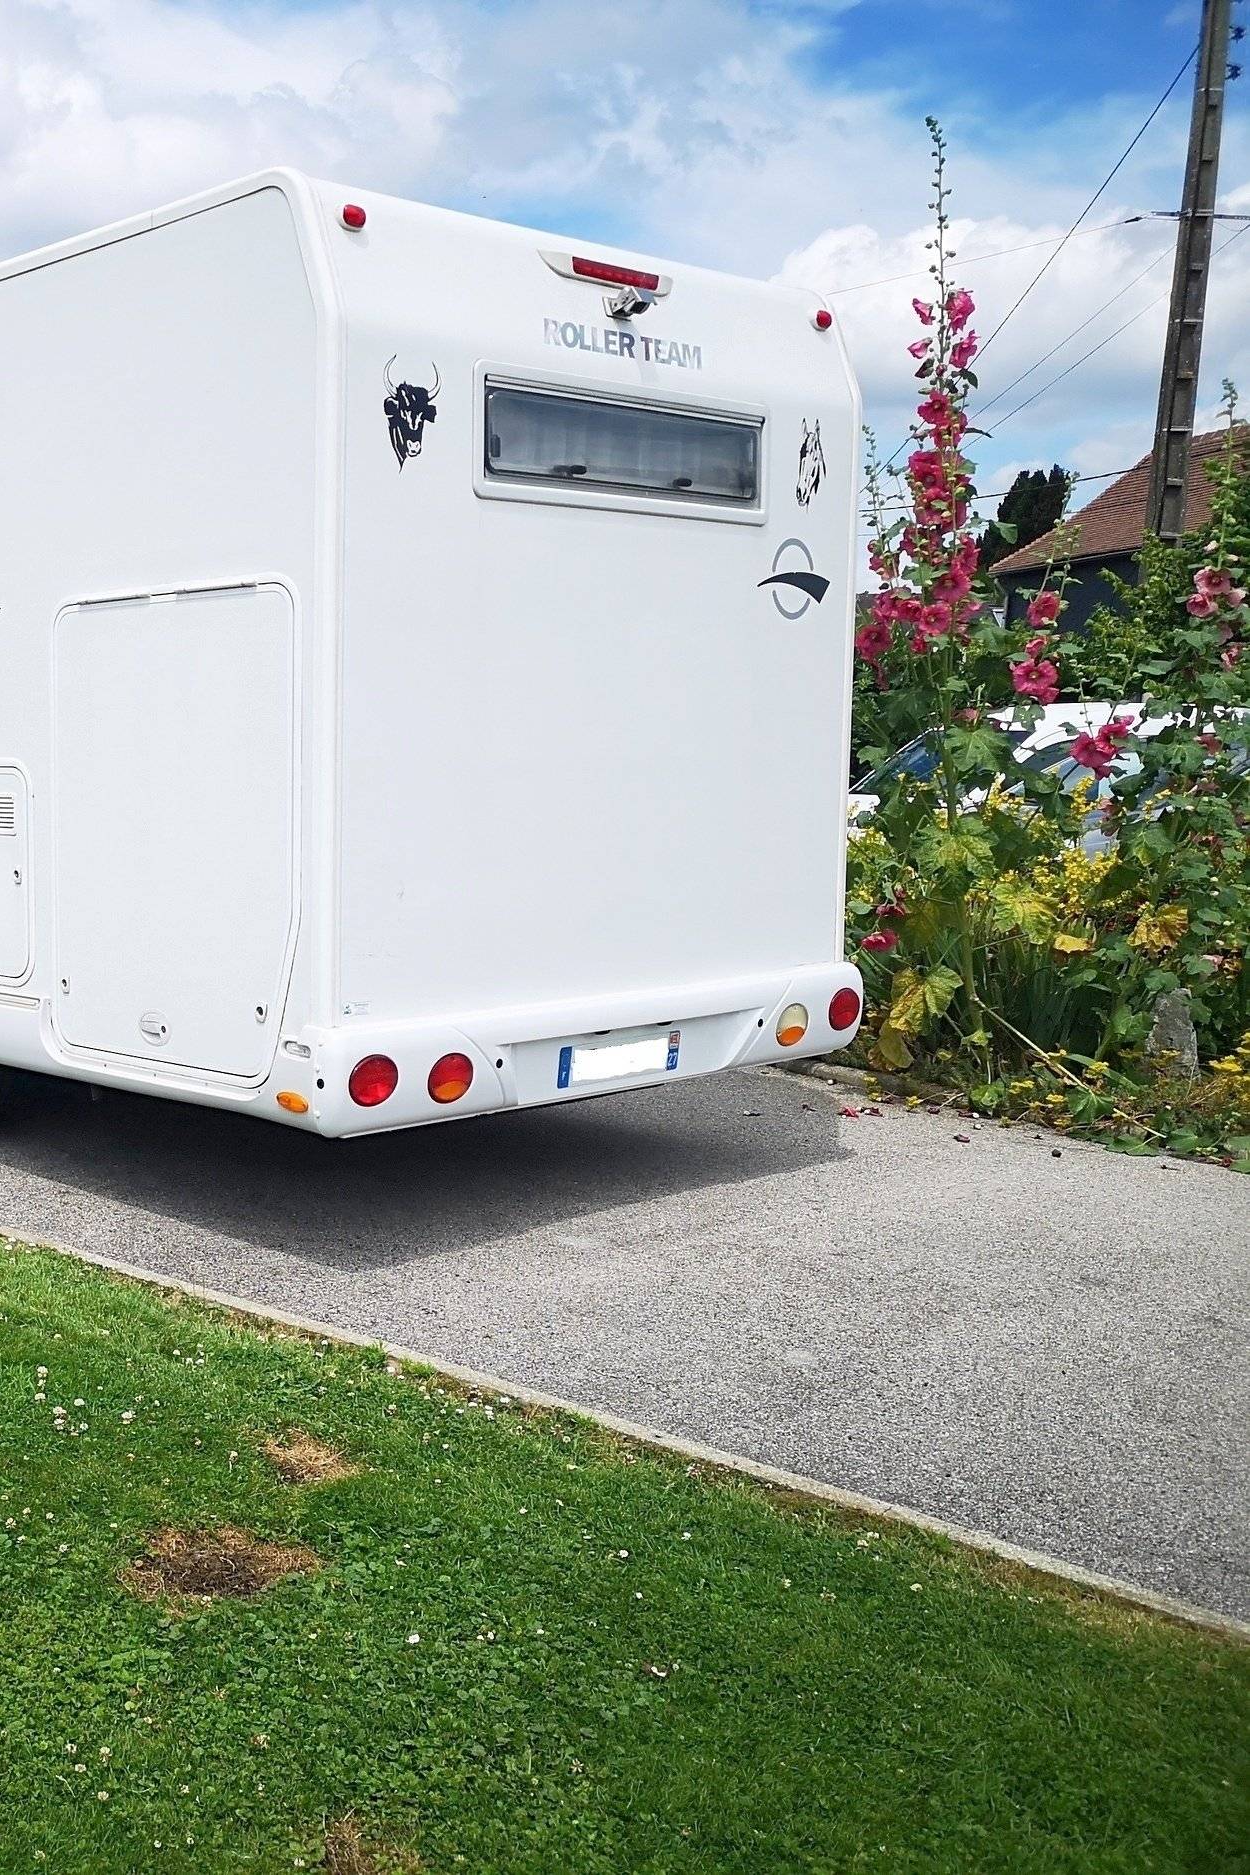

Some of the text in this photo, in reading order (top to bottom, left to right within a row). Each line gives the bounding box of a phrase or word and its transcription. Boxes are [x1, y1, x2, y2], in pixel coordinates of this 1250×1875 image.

[543, 318, 703, 370] ROLLER TEAM
[667, 1052, 678, 1067] 27
